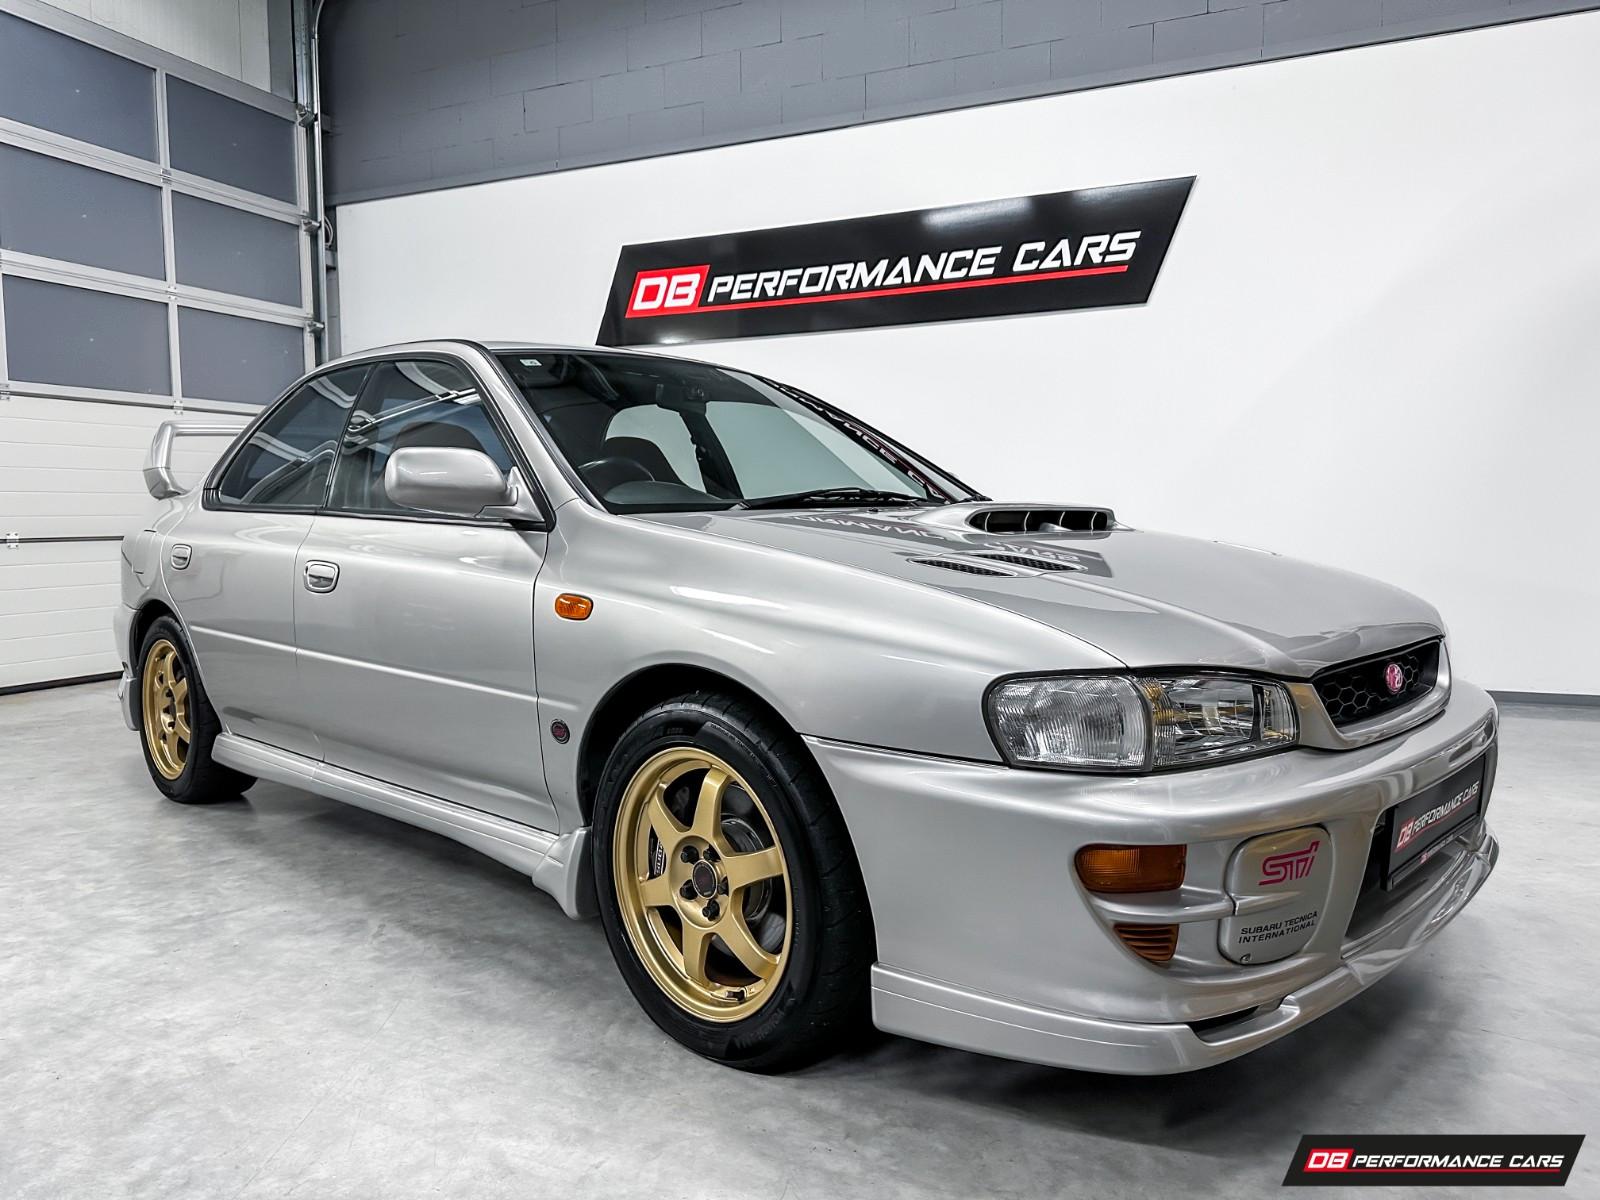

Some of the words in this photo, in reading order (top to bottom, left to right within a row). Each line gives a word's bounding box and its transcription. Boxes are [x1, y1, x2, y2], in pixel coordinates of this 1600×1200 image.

[632, 273, 702, 311] DB
[707, 246, 1003, 303] PERFORMANCE
[1012, 230, 1142, 273] CARS
[1396, 820, 1414, 849] DB
[1238, 919, 1316, 944] INTERNATIONAL
[1240, 922, 1282, 935] SUBARU
[1284, 911, 1318, 927] TECNICA
